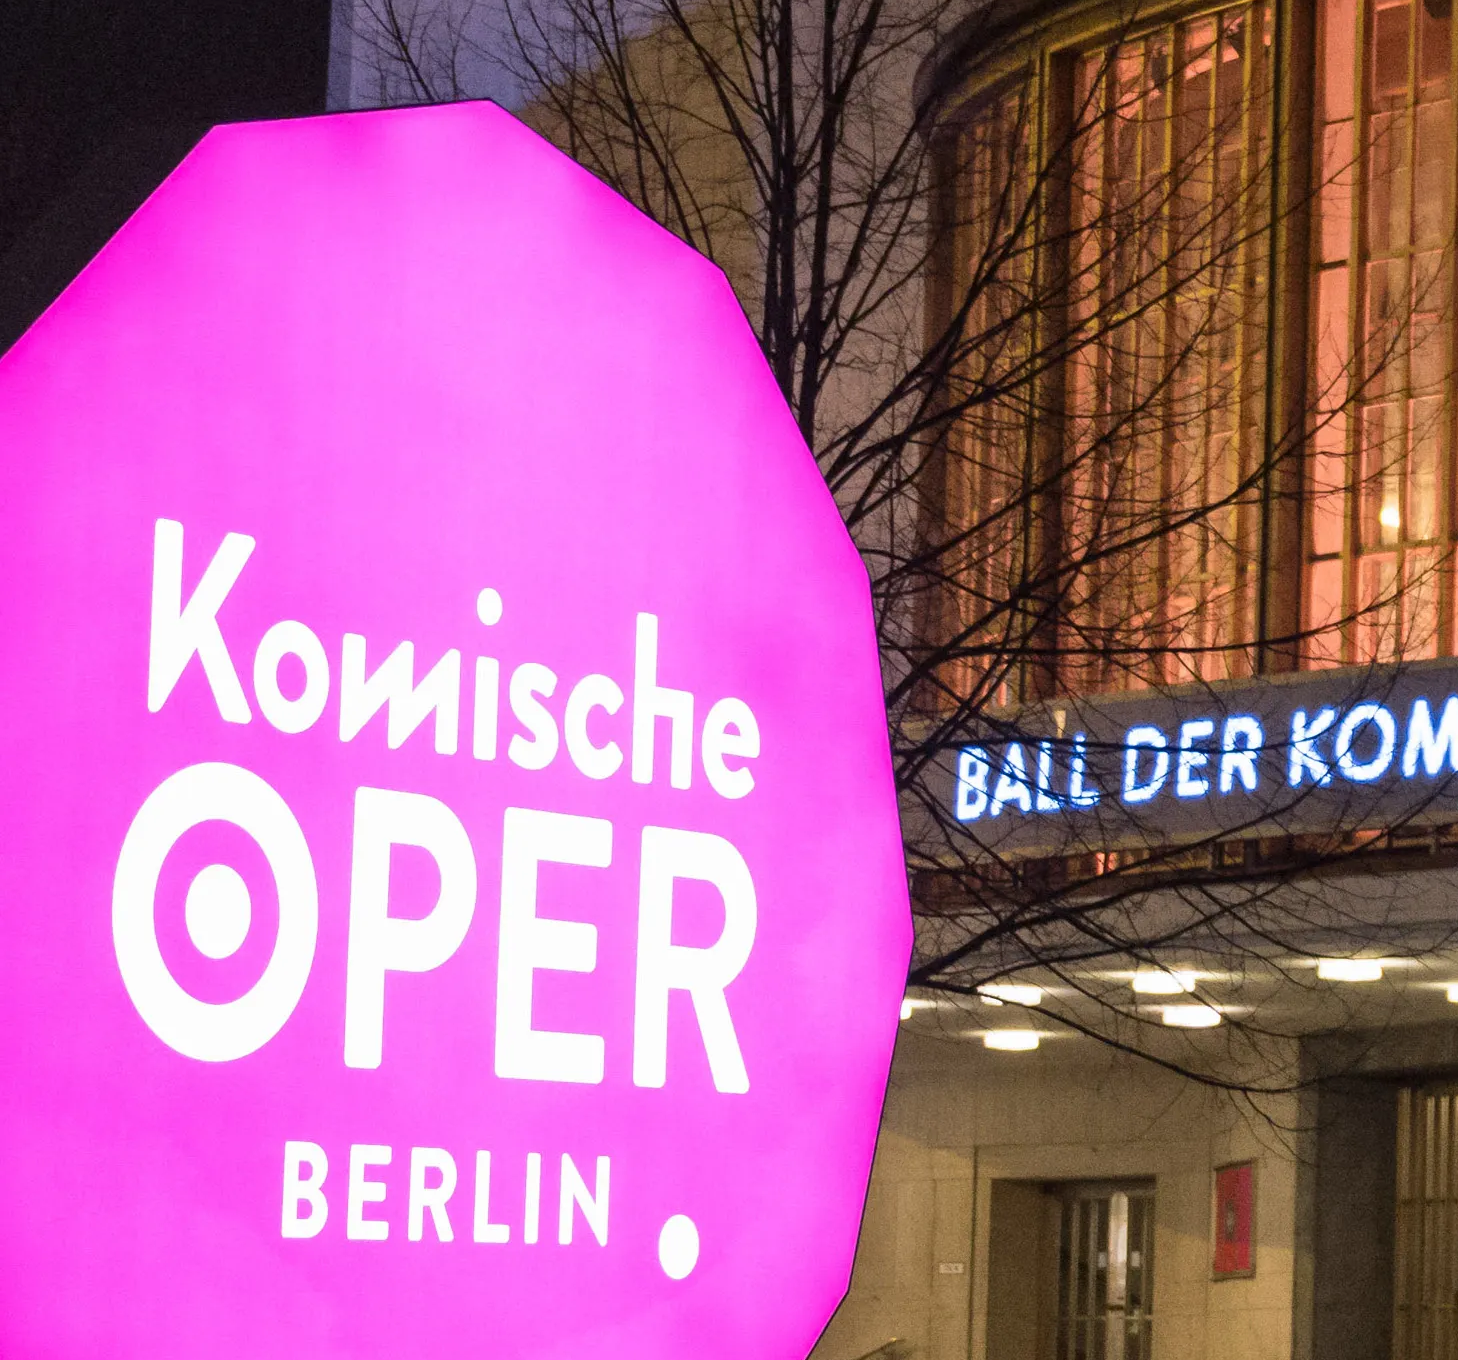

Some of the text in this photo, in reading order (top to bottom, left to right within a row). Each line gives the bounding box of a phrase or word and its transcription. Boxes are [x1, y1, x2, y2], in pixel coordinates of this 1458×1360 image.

[147, 517, 762, 800] Komische
[955, 731, 1101, 822] BALL
[1121, 716, 1265, 804] DER
[111, 761, 759, 1095] OPER
[281, 1140, 611, 1247] BERLIN
